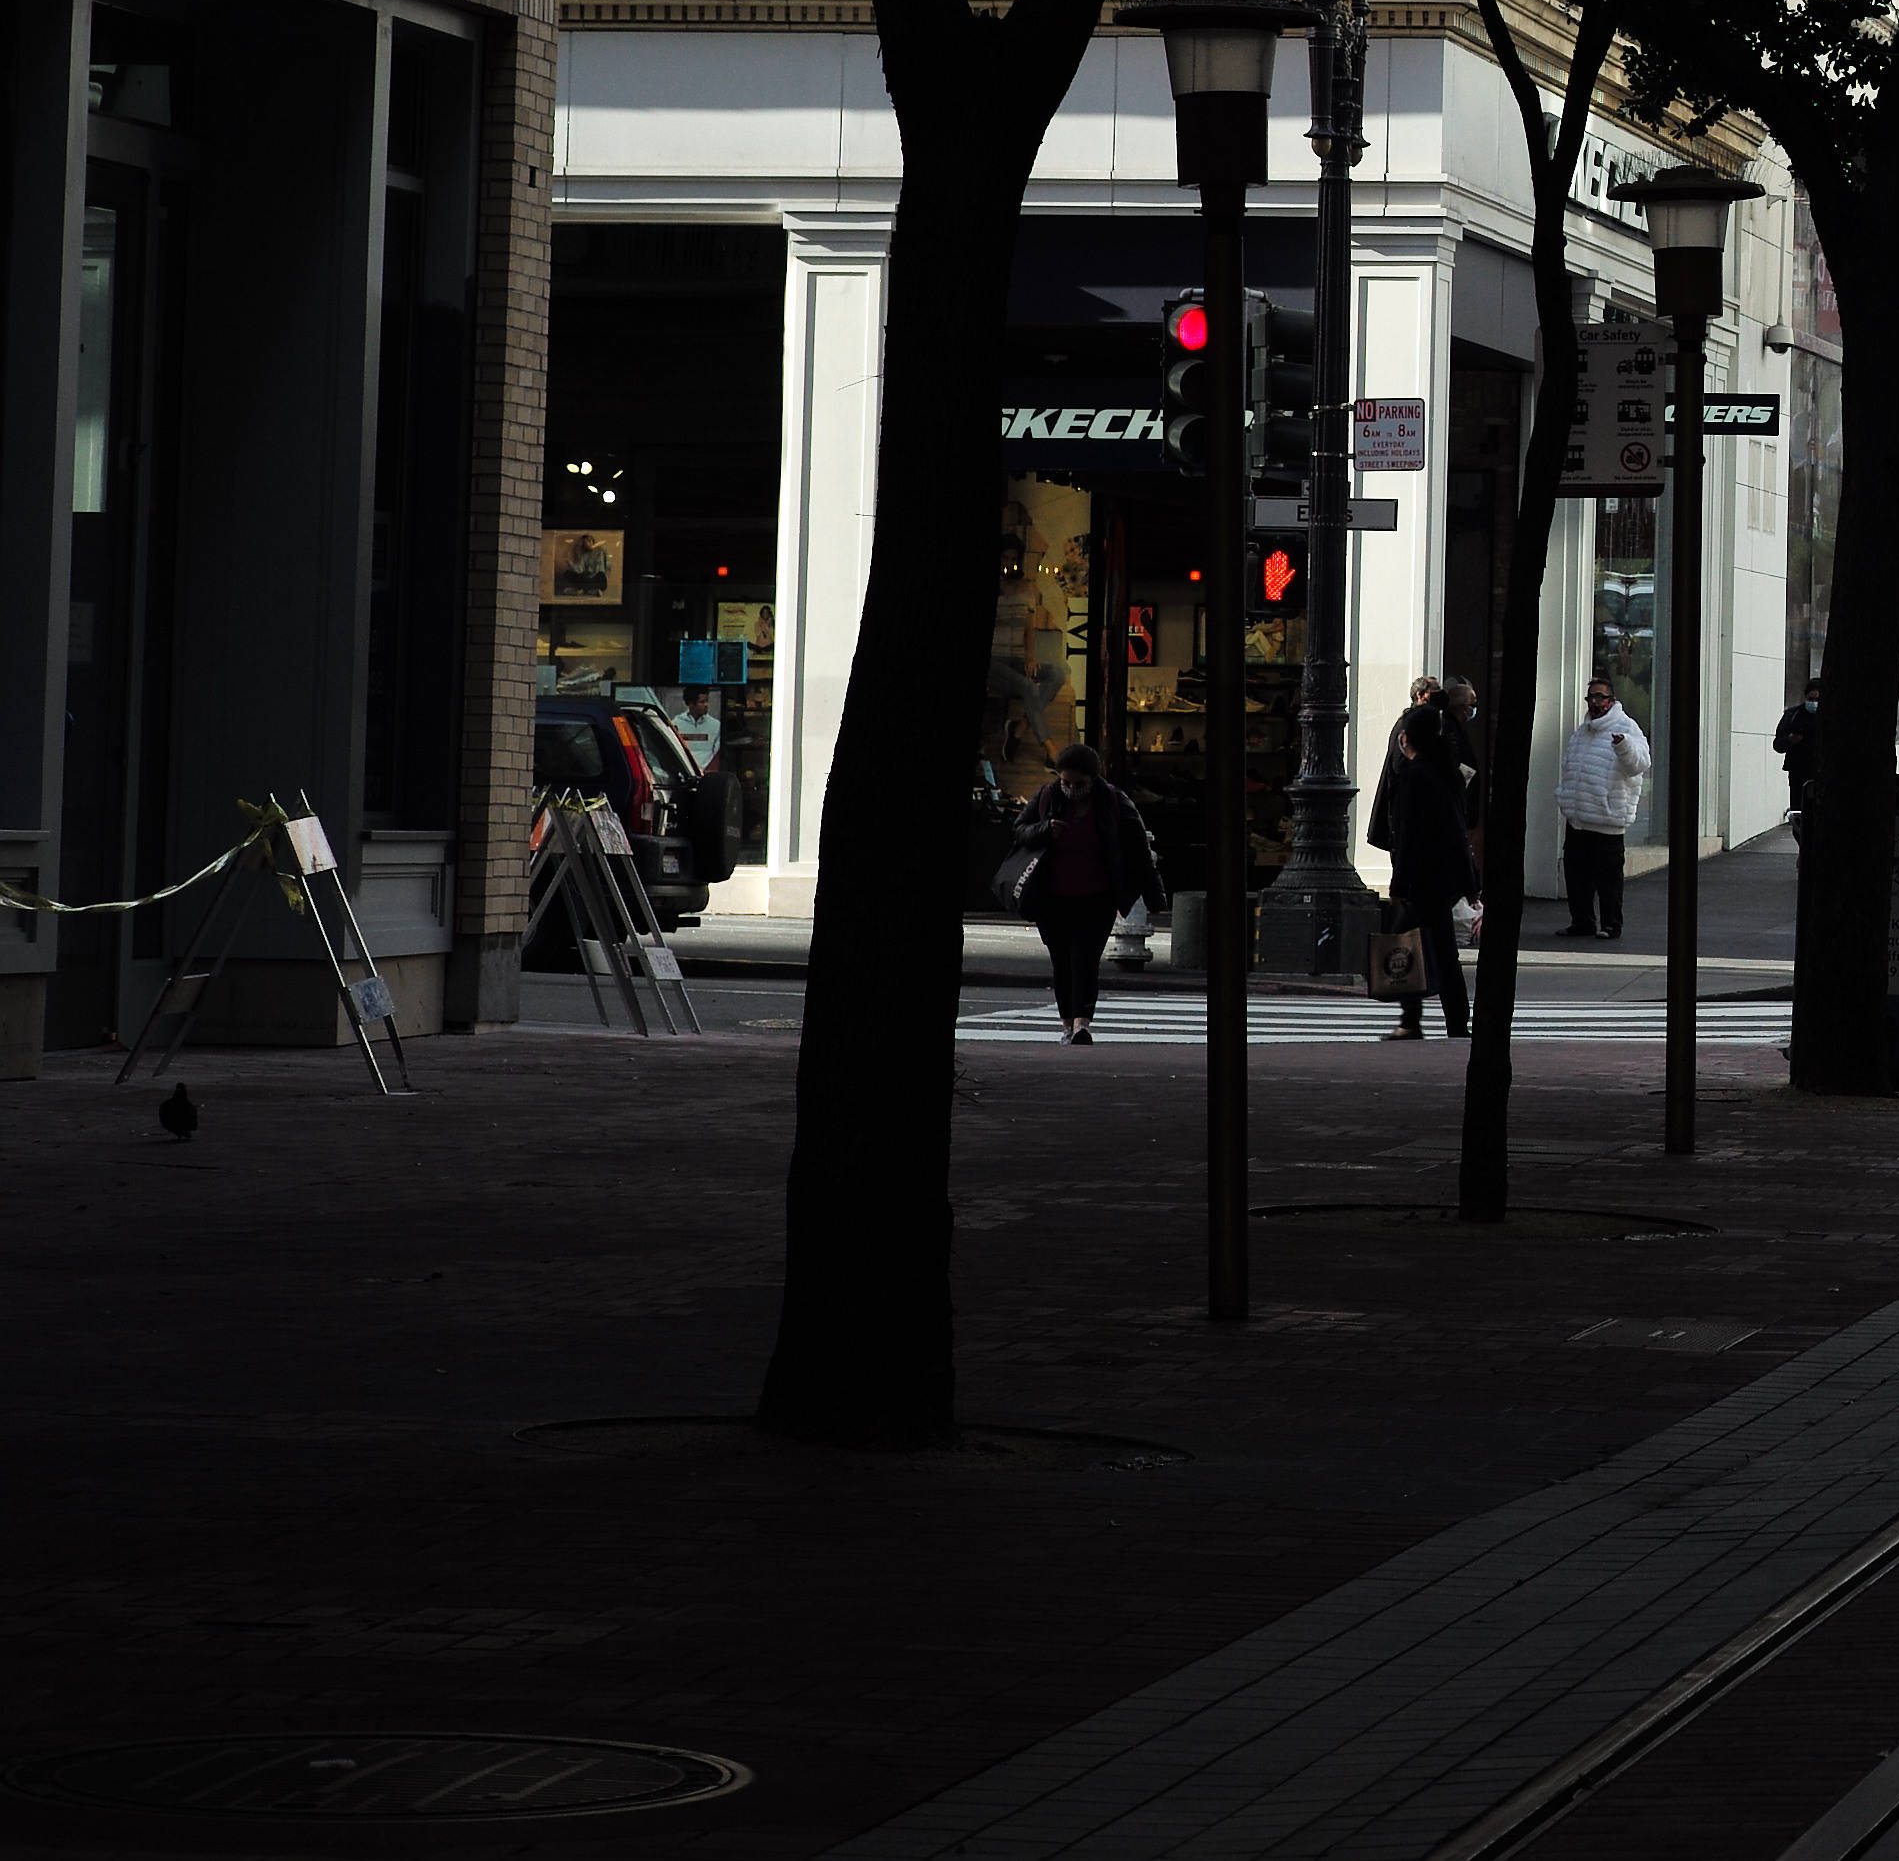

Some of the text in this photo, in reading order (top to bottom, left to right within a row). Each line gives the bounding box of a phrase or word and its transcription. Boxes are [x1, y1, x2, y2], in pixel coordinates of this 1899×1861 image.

[1579, 328, 1641, 342] Car Safety
[1356, 401, 1421, 420] NO PARKING
[1013, 857, 1039, 898] KOHLER
